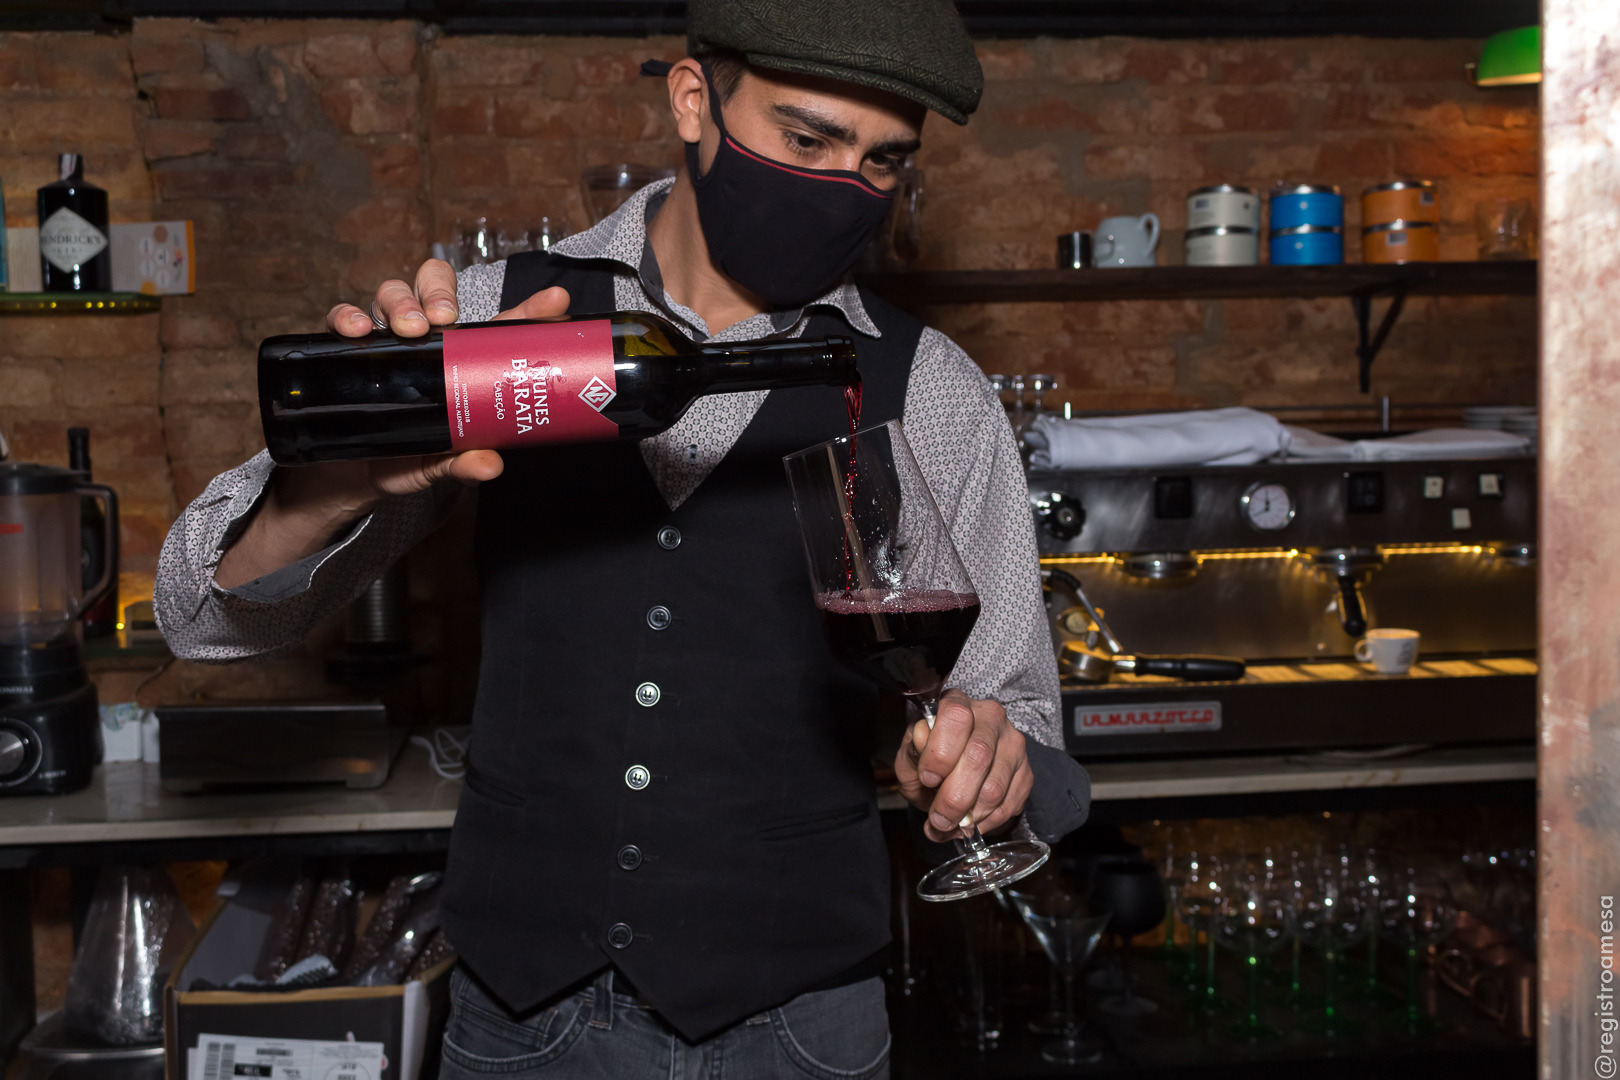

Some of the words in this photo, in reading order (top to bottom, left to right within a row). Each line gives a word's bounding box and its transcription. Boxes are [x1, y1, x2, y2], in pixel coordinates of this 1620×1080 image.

[493, 381, 505, 420] CABEÇÃO
[511, 358, 533, 435] BARATA
[531, 367, 550, 426] NUNES
